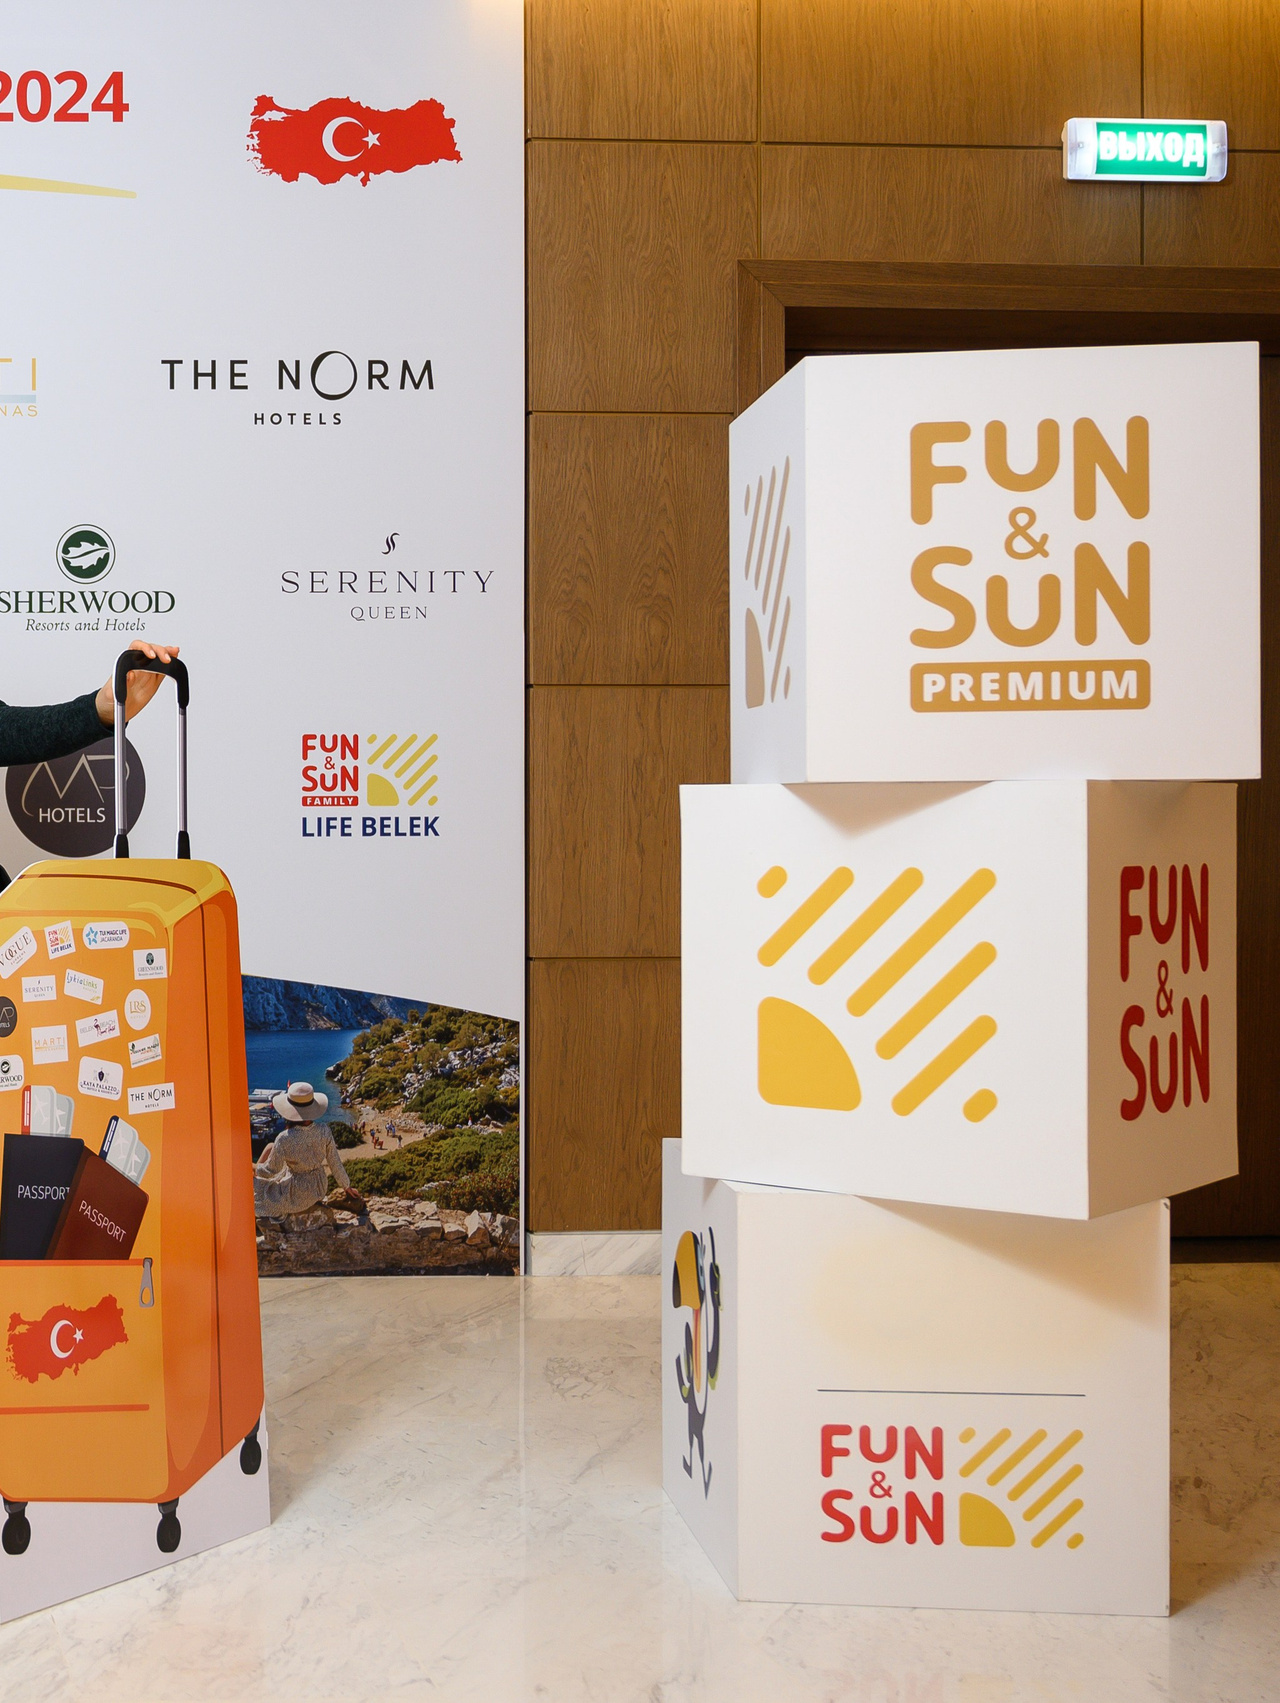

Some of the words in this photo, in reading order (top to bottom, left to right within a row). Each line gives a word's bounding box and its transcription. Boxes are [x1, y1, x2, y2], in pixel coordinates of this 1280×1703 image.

[1098, 130, 1206, 168] ВЫХОД
[161, 360, 248, 390] THE
[278, 350, 434, 401] NORM
[254, 412, 342, 425] HOTELS
[910, 415, 1150, 525] FUN
[1004, 506, 1049, 560] &
[281, 570, 495, 594] SERENITY
[909, 541, 1151, 649] SUN
[25, 618, 70, 632] Resorts
[74, 618, 100, 632] and
[104, 618, 146, 632] Hotels
[350, 606, 428, 621] QUEEN
[922, 669, 1138, 703] PREMIUM
[302, 733, 359, 761] FUN
[324, 756, 335, 770] &
[301, 765, 359, 792] SUN
[38, 807, 106, 823] HOTELS
[306, 797, 354, 805] FAMILY
[302, 816, 352, 837] LIFE
[361, 816, 440, 837] BELEK
[1120, 862, 1209, 982] FUN
[1156, 959, 1174, 1018] &
[34, 1037, 66, 1046] MARTI
[1120, 994, 1210, 1121] SUN
[130, 1092, 145, 1101] THE
[148, 1088, 172, 1101] NORM
[78, 1200, 127, 1242] PASSPORT
[820, 1424, 944, 1481] FUN
[869, 1471, 893, 1499] &
[820, 1489, 944, 1546] SUN
